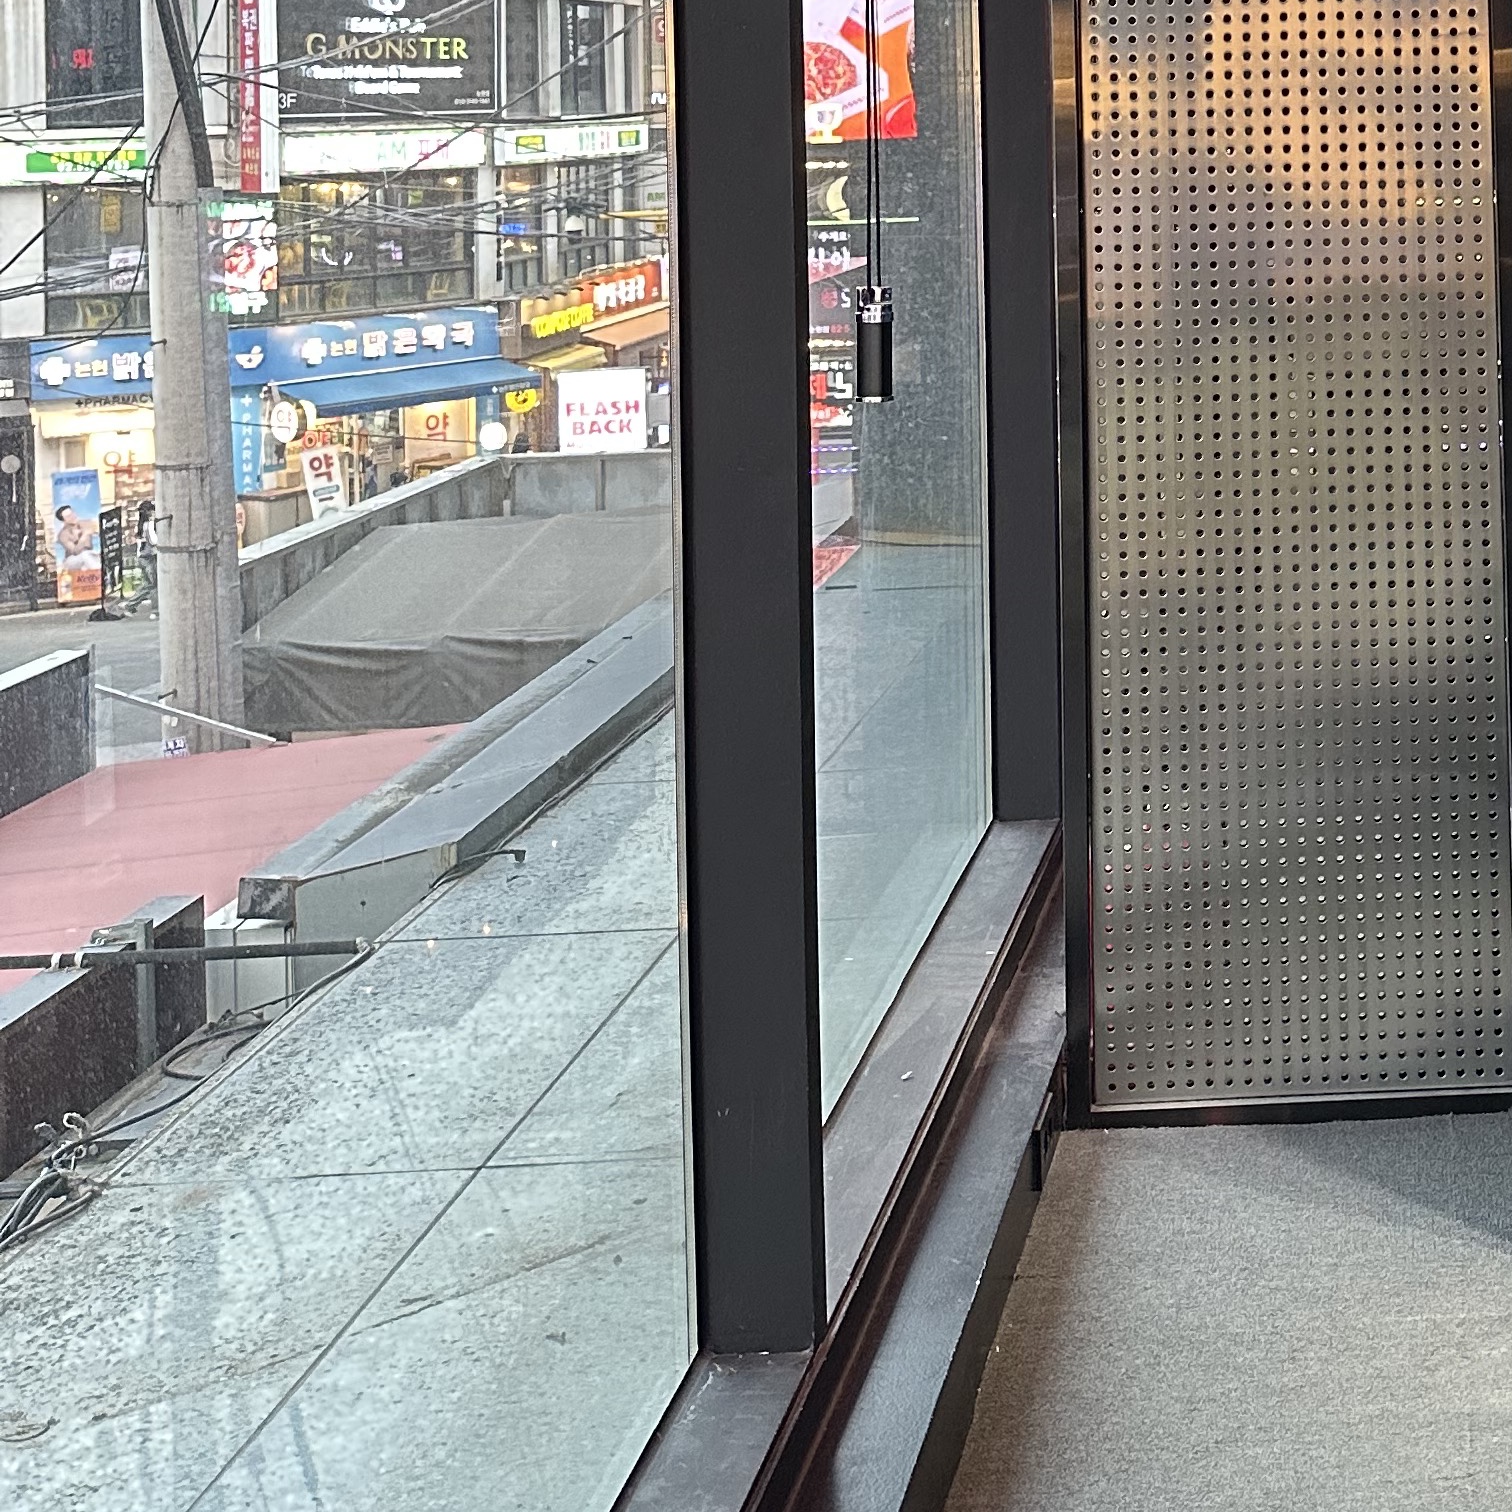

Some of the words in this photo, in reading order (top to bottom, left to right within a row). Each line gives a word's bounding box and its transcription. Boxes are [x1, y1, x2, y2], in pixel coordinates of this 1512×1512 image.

[278, 92, 297, 109] 3F
[565, 399, 640, 417] FLASH
[425, 411, 450, 443] 약
[572, 419, 633, 436] BACK
[308, 453, 335, 483] 약
